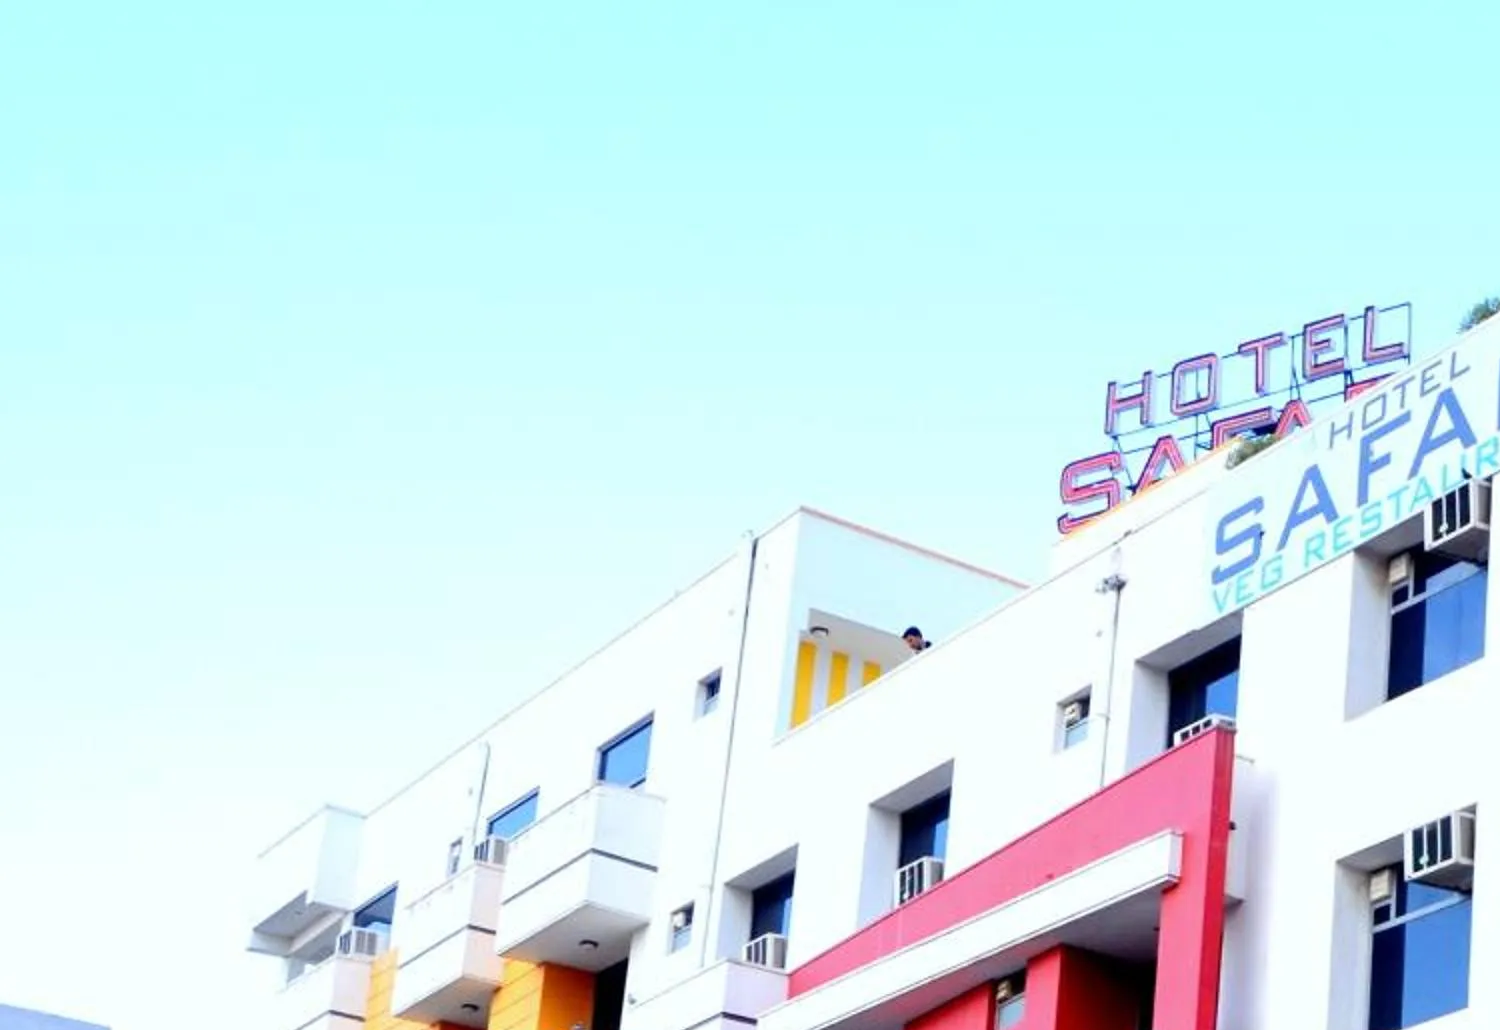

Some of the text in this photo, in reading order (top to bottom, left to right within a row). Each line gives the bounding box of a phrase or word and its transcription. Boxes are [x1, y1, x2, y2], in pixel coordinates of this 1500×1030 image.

[1104, 305, 1406, 435] HOTEL
[1328, 350, 1471, 450] HOTEL
[1211, 551, 1284, 615] VEG
